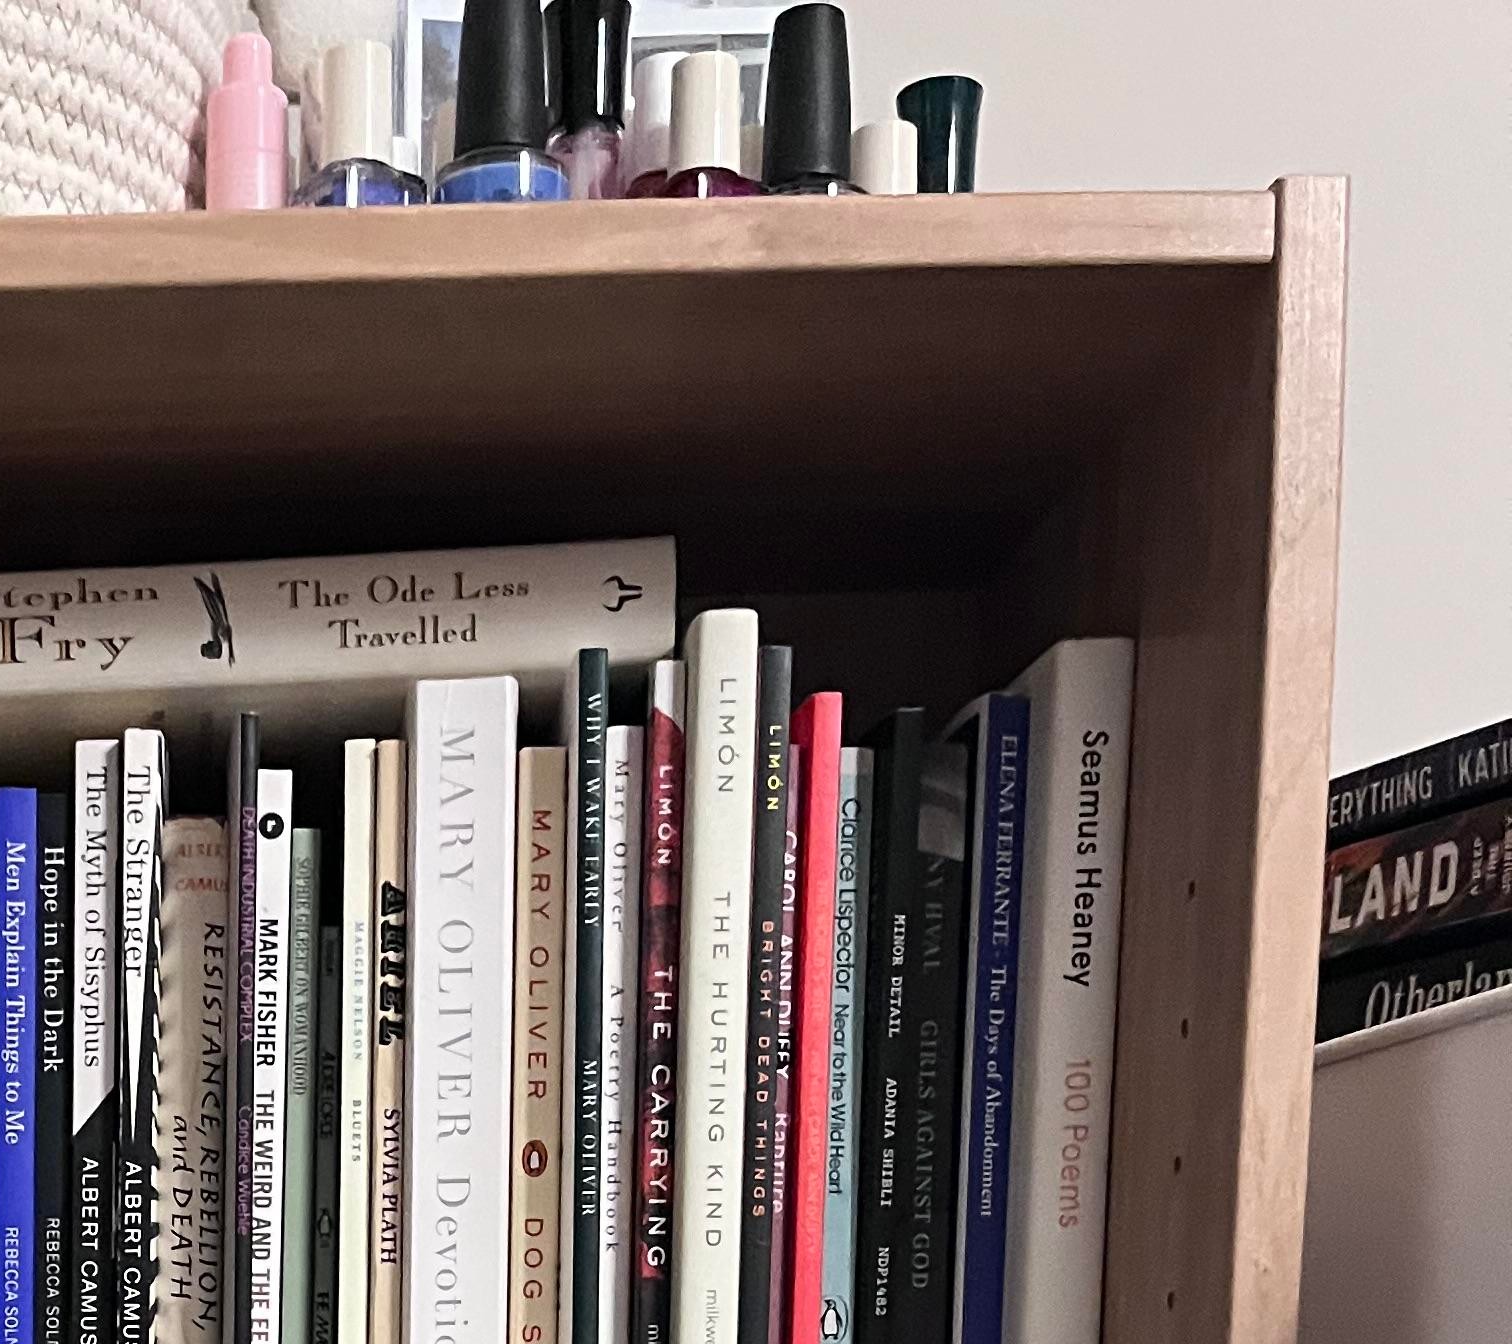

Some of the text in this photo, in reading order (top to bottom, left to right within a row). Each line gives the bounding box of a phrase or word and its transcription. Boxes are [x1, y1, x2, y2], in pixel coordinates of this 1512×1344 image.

[279, 571, 530, 609] The Ode Less
[328, 612, 477, 648] Travelled
[125, 766, 151, 979] The Stranger
[438, 727, 476, 893] MARY
[1063, 730, 1109, 987] Seamus Heaney
[1328, 841, 1459, 934] LAND
[84, 767, 108, 1069] The Myth of Sisyphus
[705, 678, 737, 1248] LIMÓN THE HURTING KIND
[434, 919, 475, 1141] OLIVER
